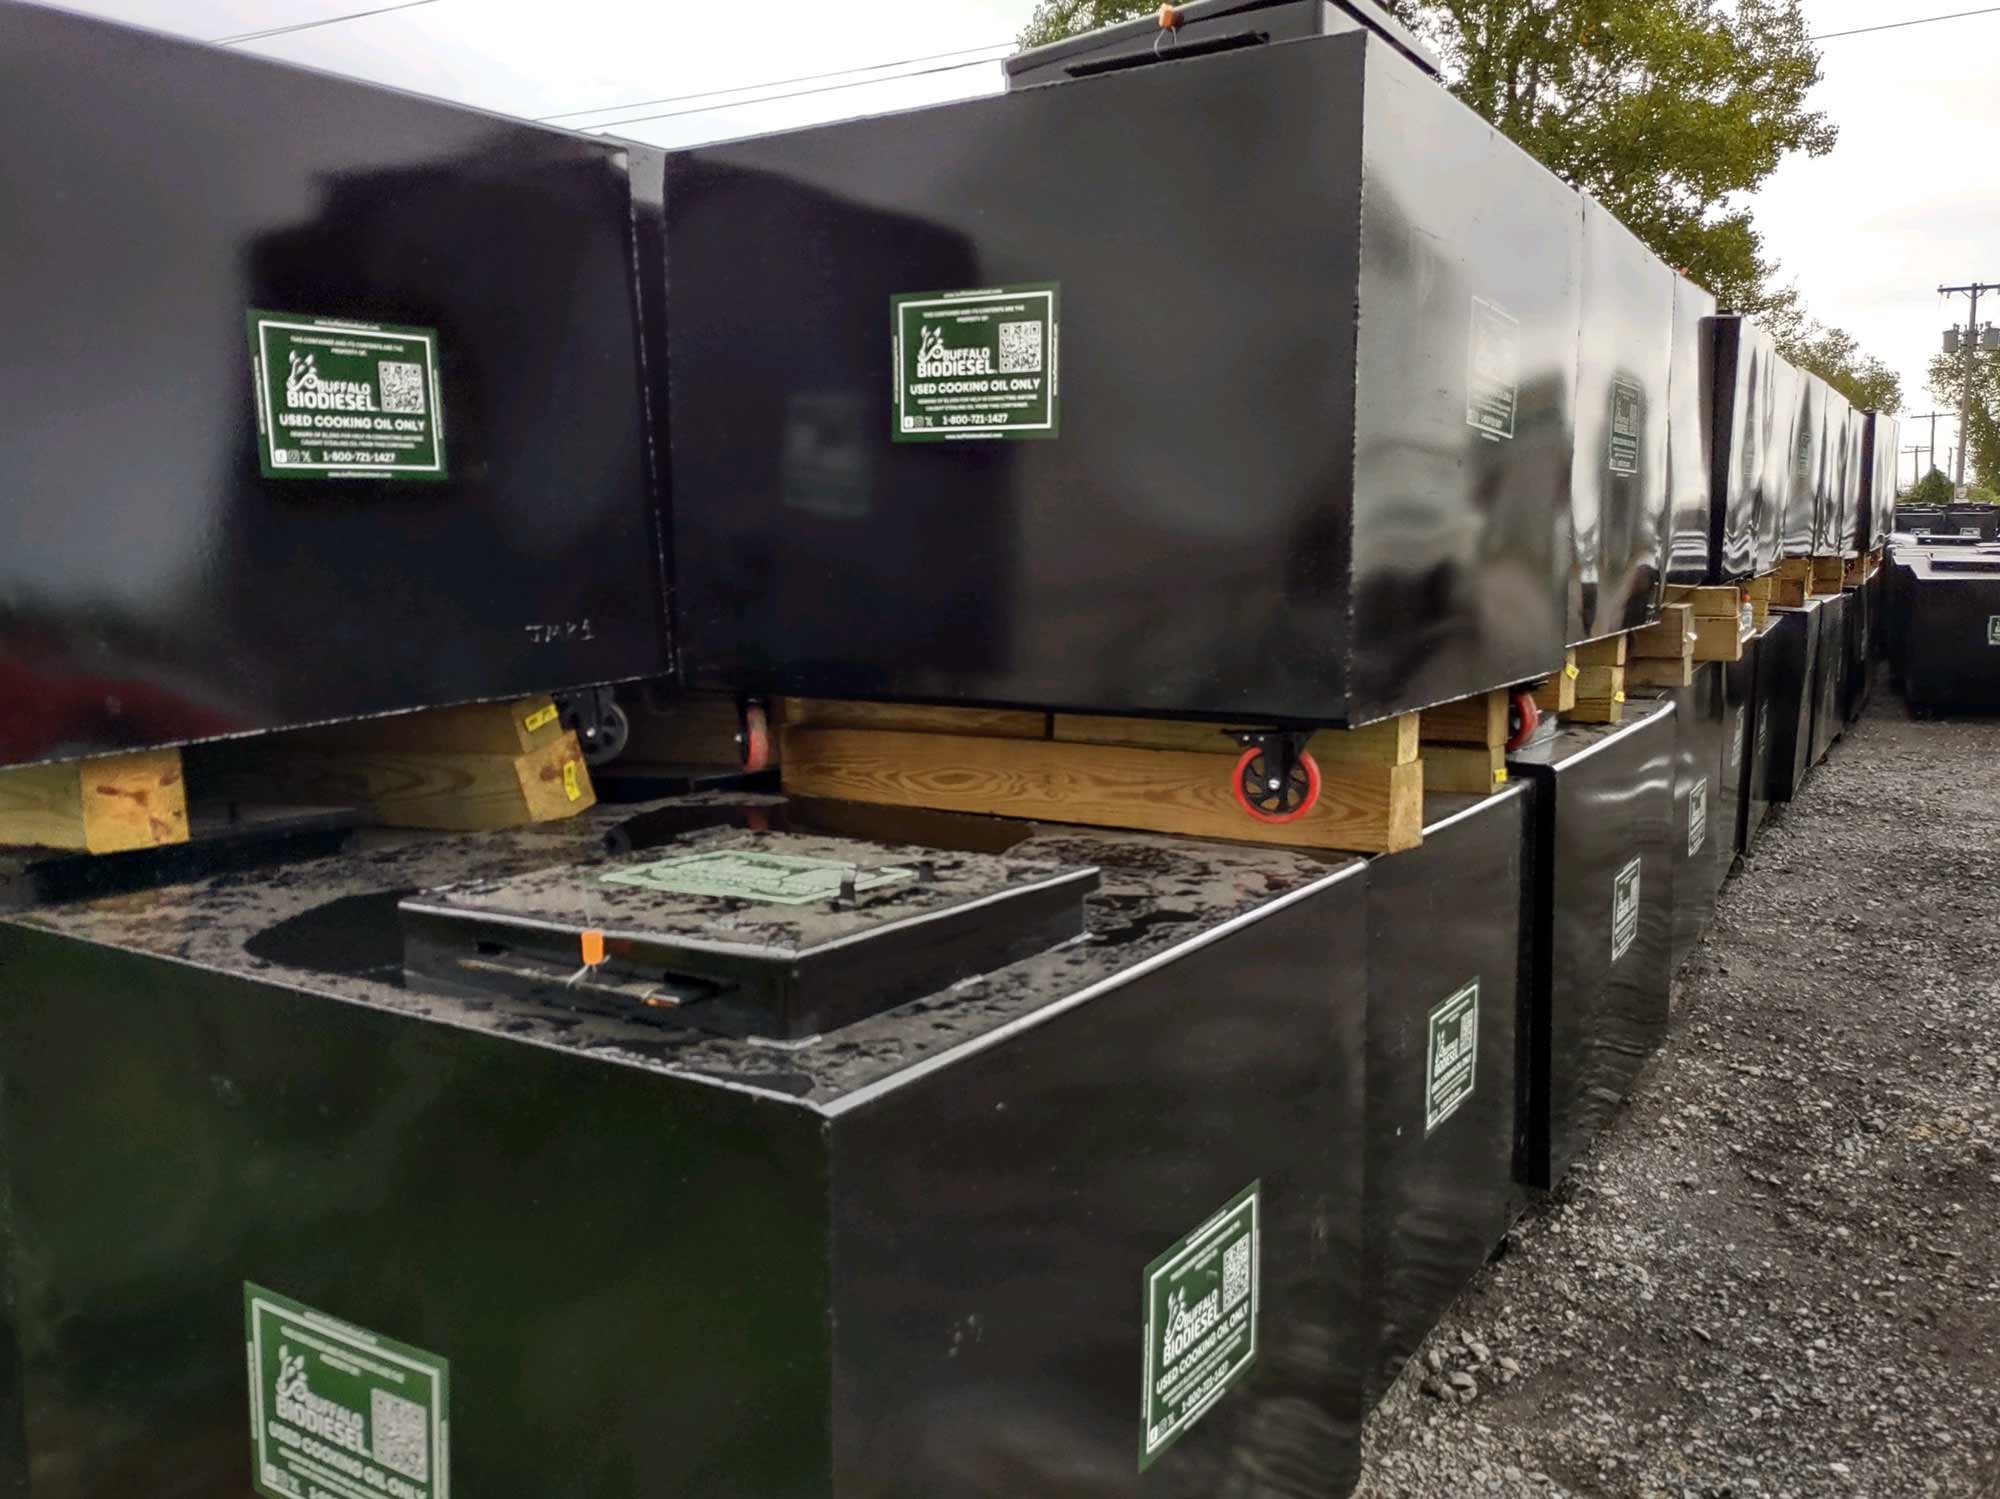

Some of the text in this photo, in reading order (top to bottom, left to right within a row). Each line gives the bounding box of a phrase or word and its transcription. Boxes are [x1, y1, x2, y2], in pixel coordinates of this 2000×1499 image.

[944, 347, 990, 362] BUFFALO
[917, 360, 993, 378] BIODIESEL
[316, 380, 371, 395] BUFFALO
[910, 378, 1041, 395] USED COOKING OIL ONLY
[286, 391, 374, 411] BIODIESEL
[279, 414, 426, 431] USED COOKING OIL ONLY
[942, 413, 1008, 425] 1-800-721-1427
[322, 450, 396, 462] 1-800-721-1427
[1183, 1288, 1218, 1328] BUFFALO
[1163, 1303, 1219, 1367] BIODIESEL
[1156, 1300, 1249, 1394] USED COOKING OIL ONLY
[275, 1393, 368, 1455] BIODIESEL
[302, 1436, 363, 1479] COOKING
